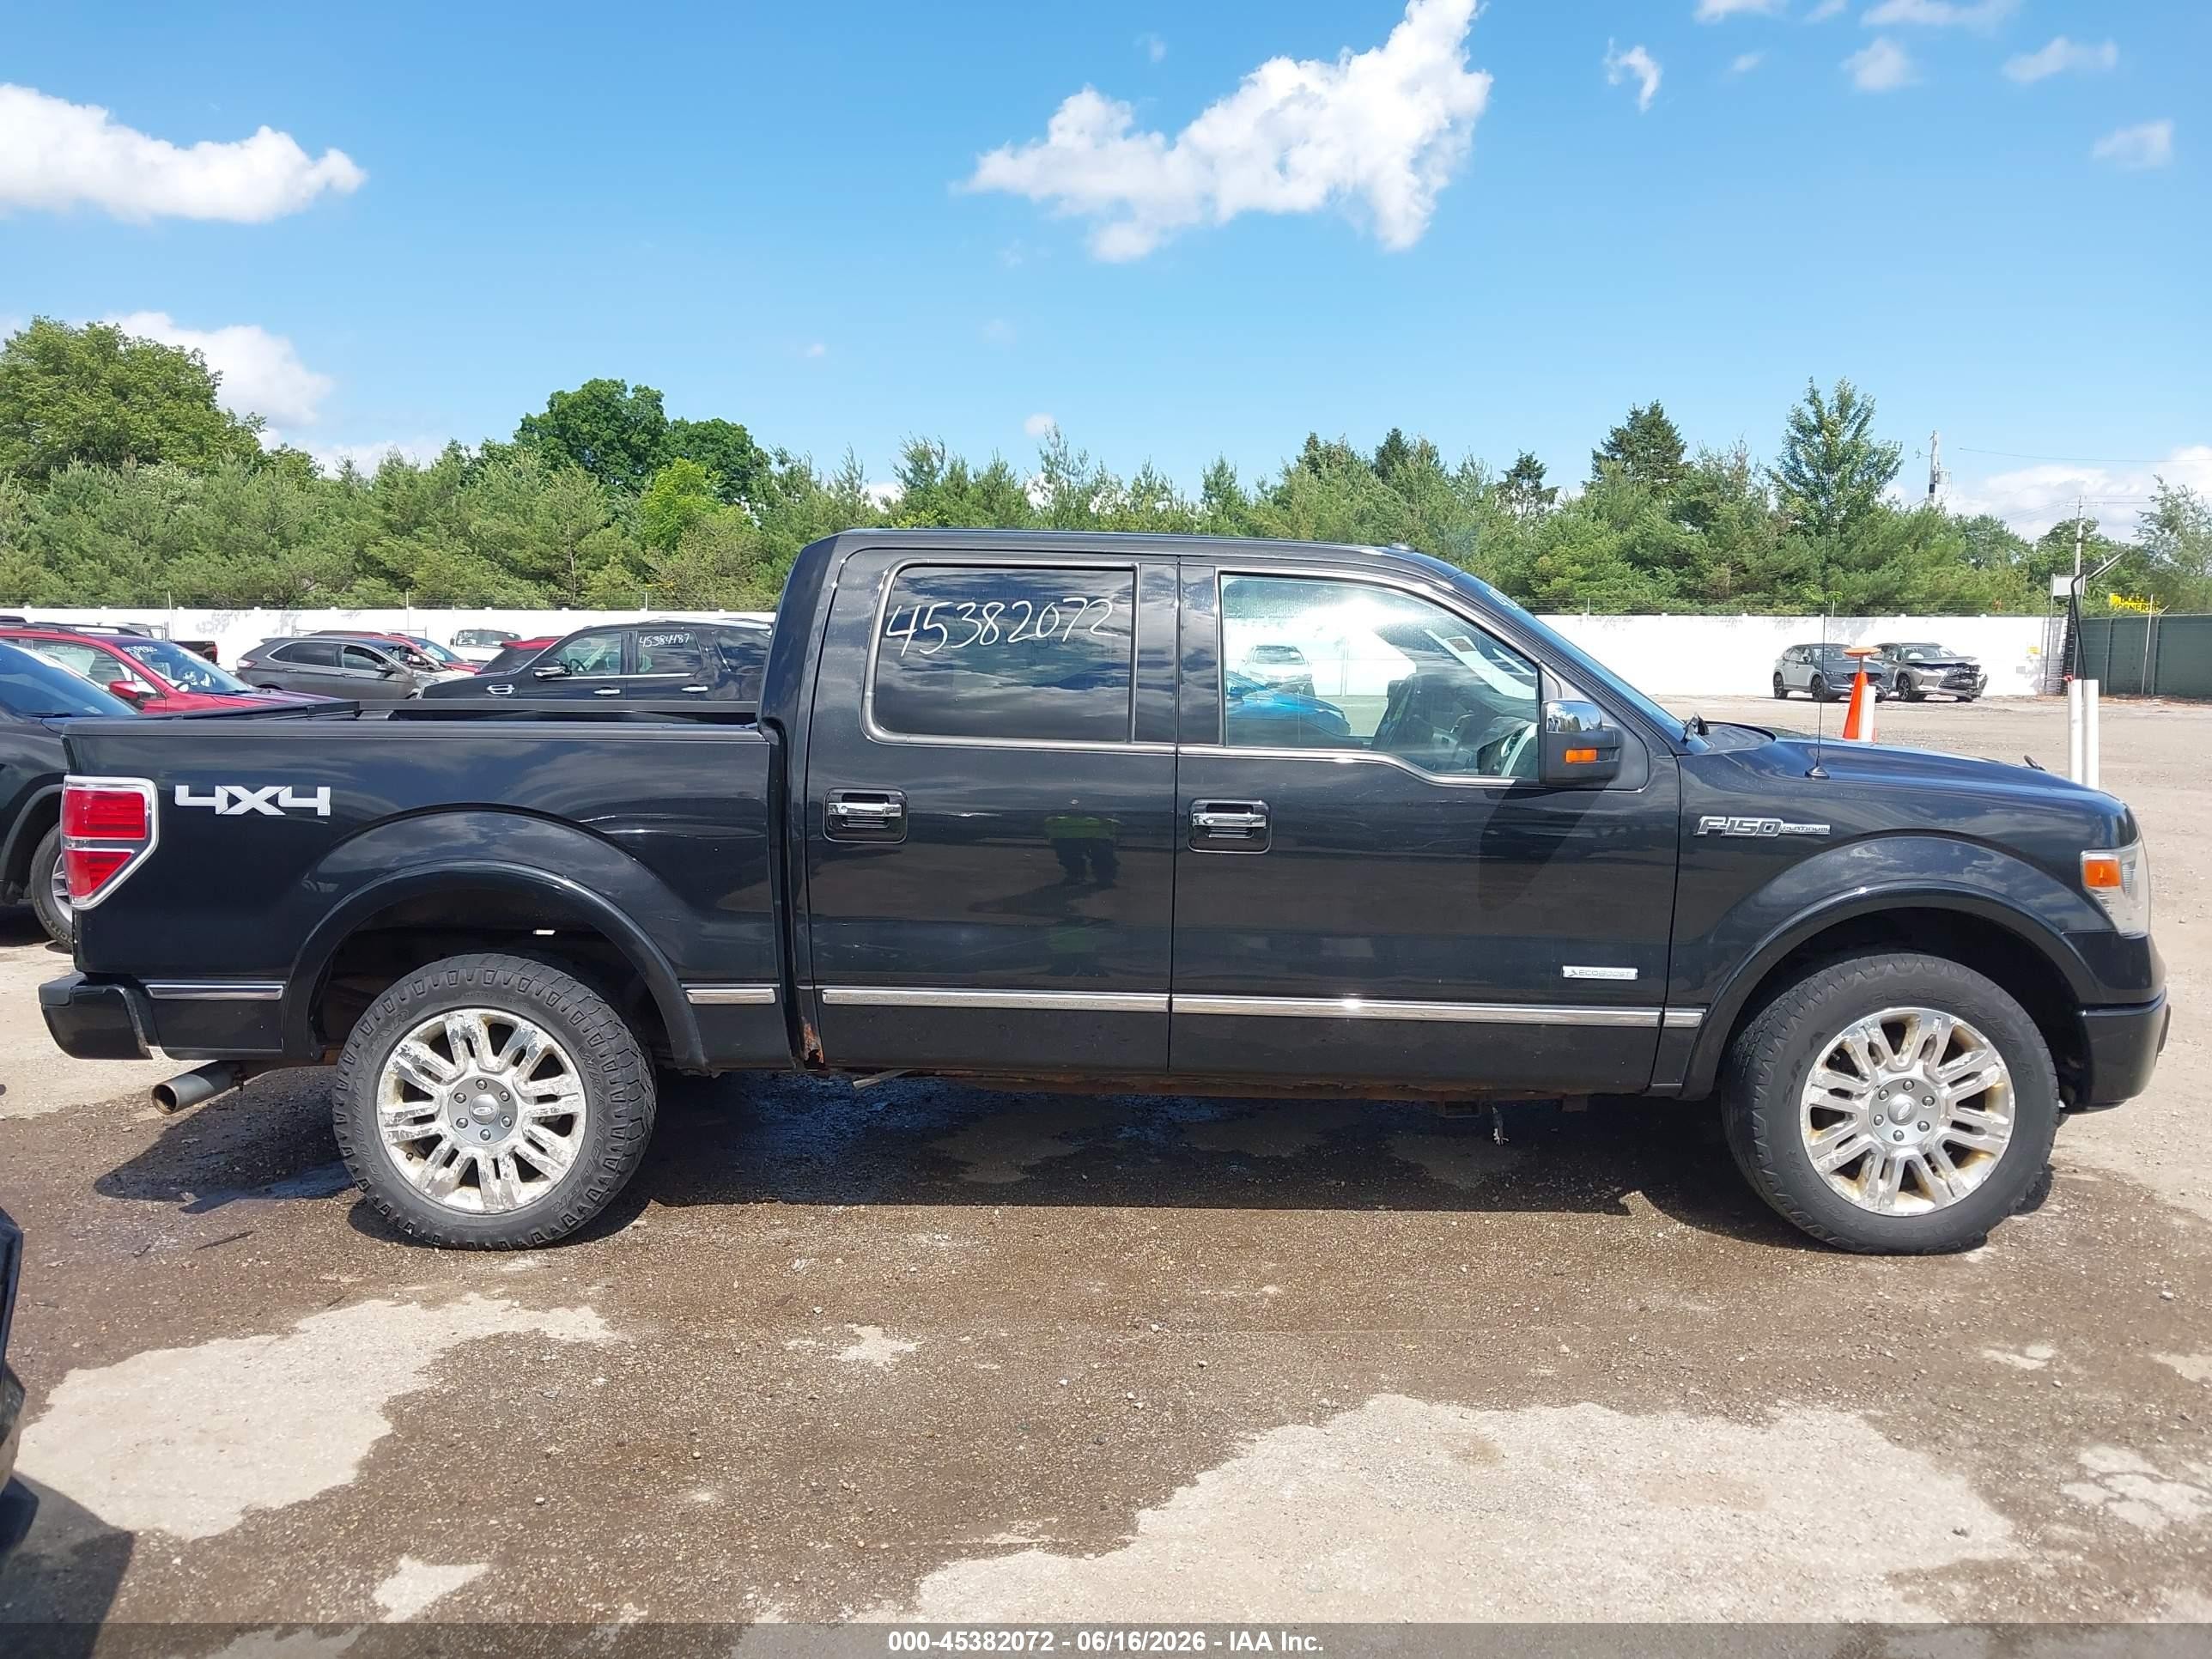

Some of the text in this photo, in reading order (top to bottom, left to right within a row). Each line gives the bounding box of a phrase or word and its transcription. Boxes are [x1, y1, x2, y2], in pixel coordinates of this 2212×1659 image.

[885, 598, 1119, 657] 45382072
[1694, 816, 1831, 837] F-150 PLATINUM
[550, 1045, 608, 1212] WRANGLER
